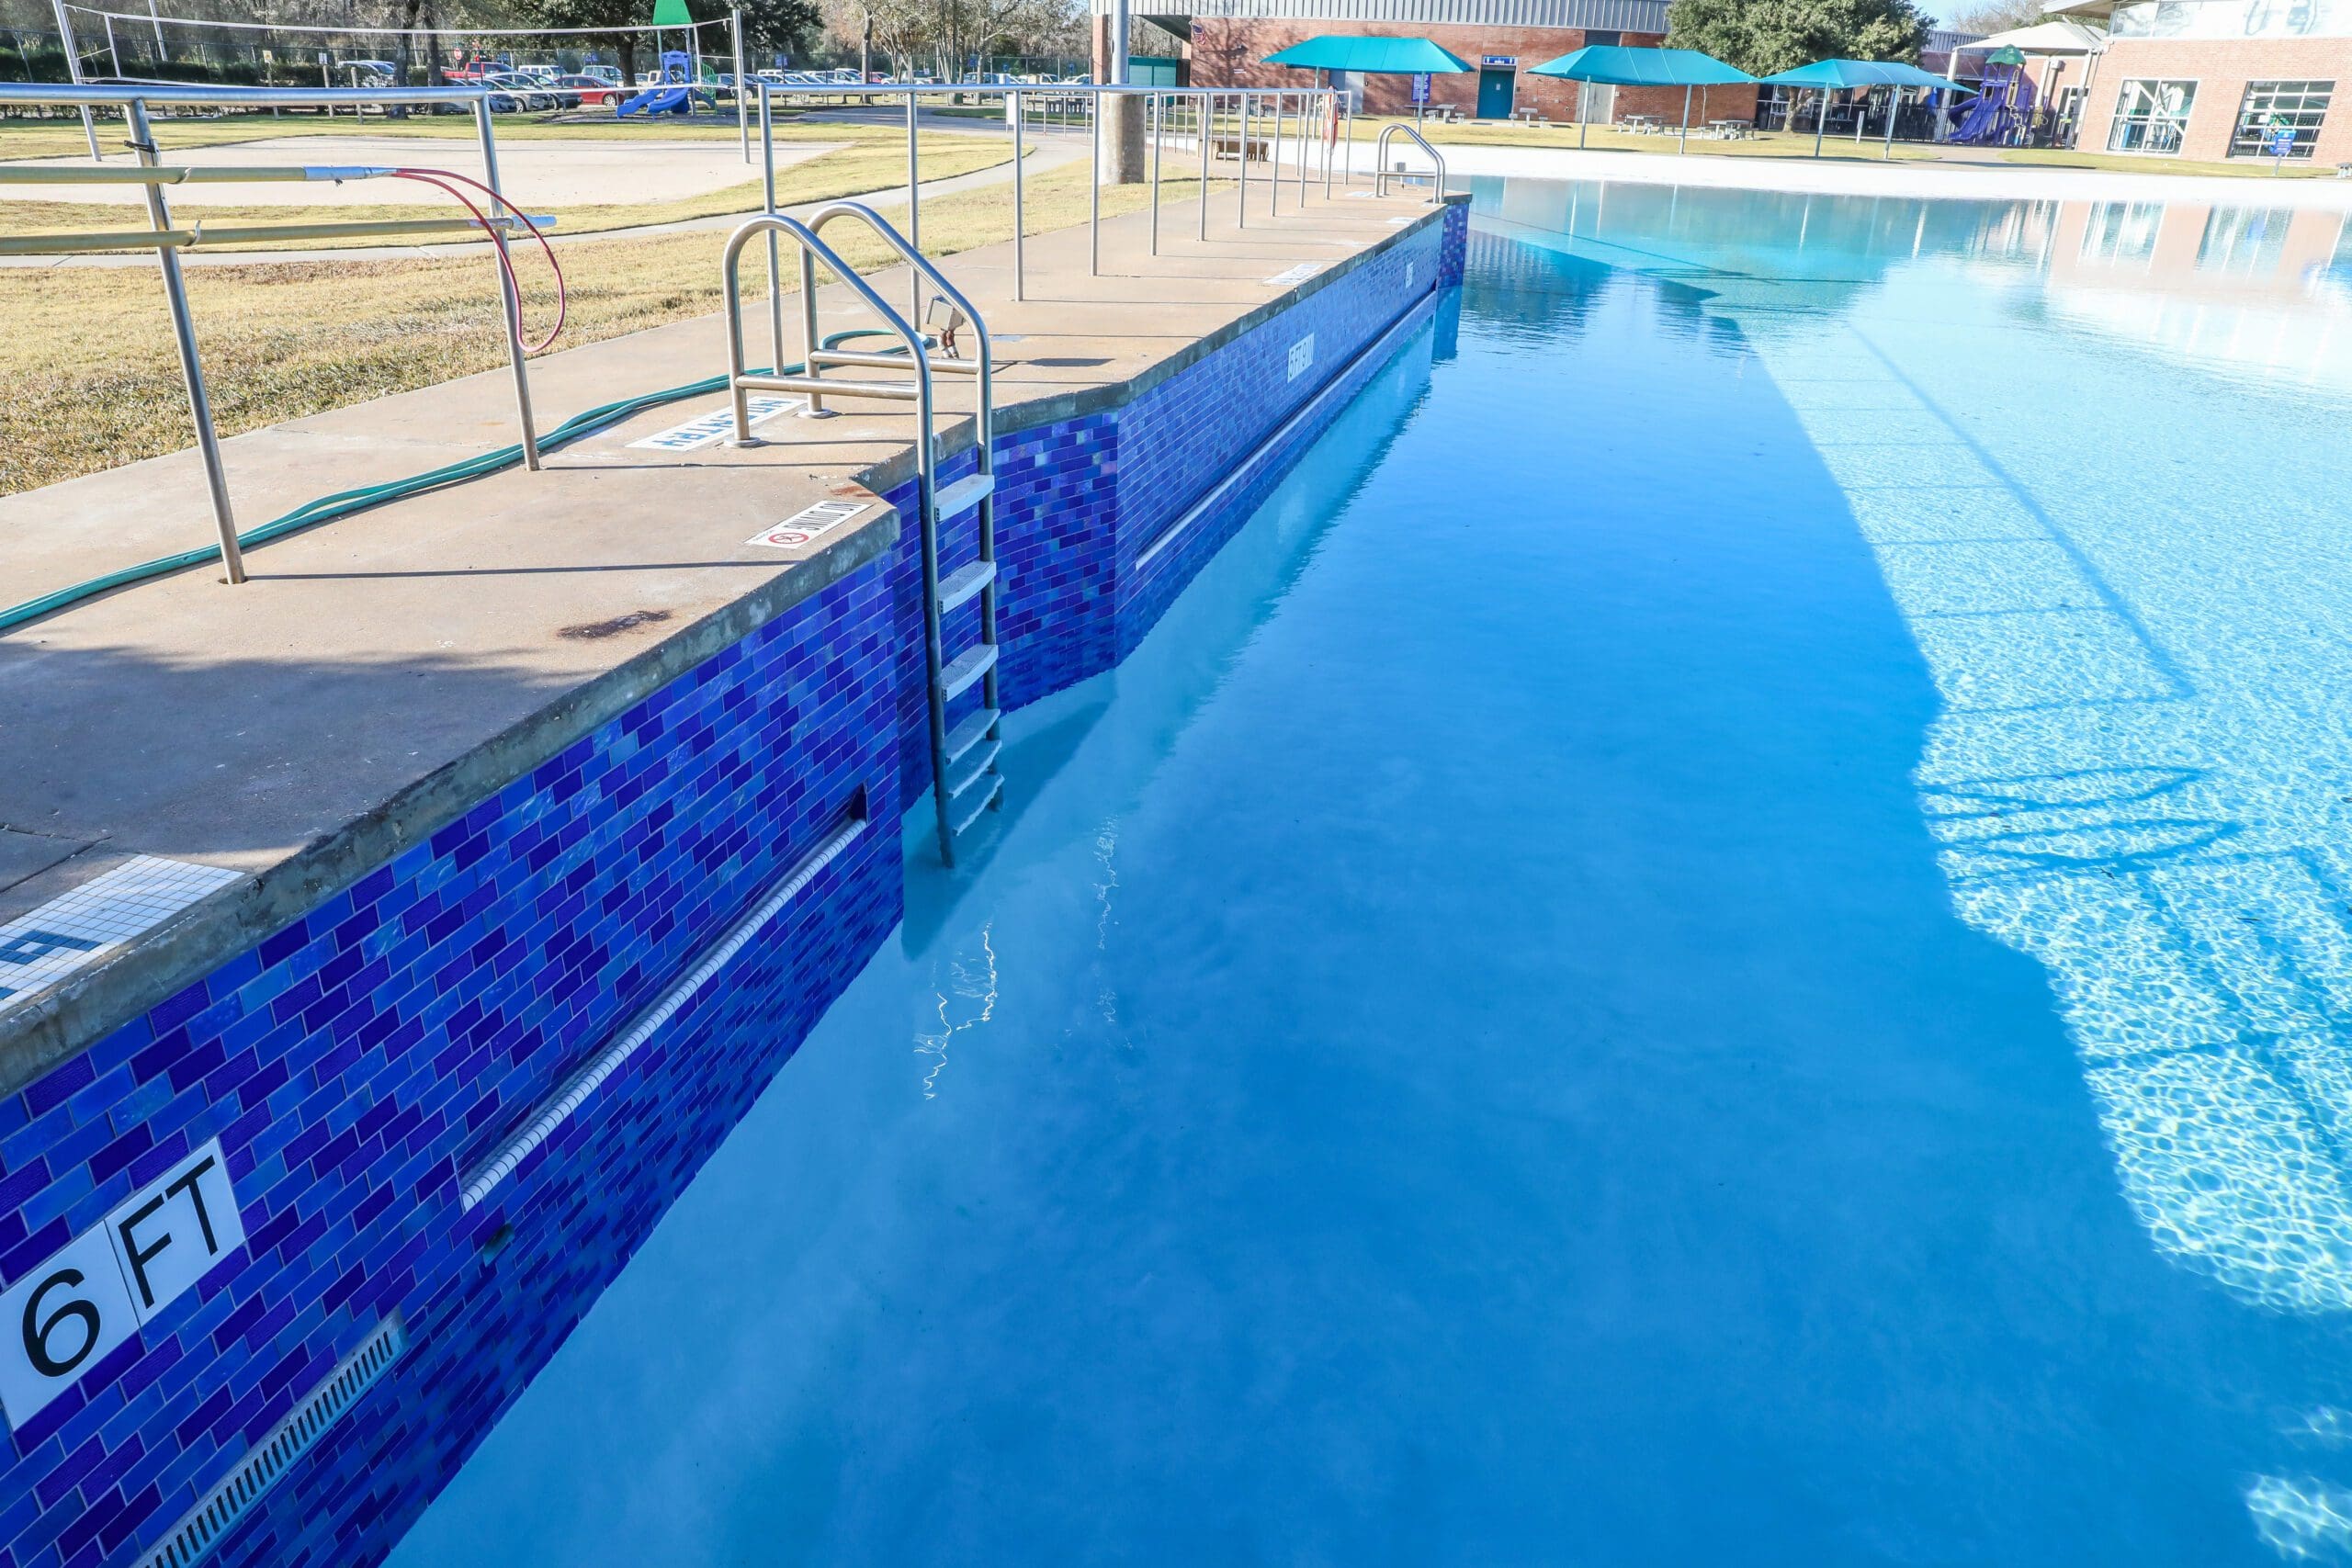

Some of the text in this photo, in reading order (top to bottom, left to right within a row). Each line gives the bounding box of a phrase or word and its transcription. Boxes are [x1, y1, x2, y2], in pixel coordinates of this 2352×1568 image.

[782, 502, 863, 531] NO DIVING
[22, 1155, 219, 1378] 6 FT
